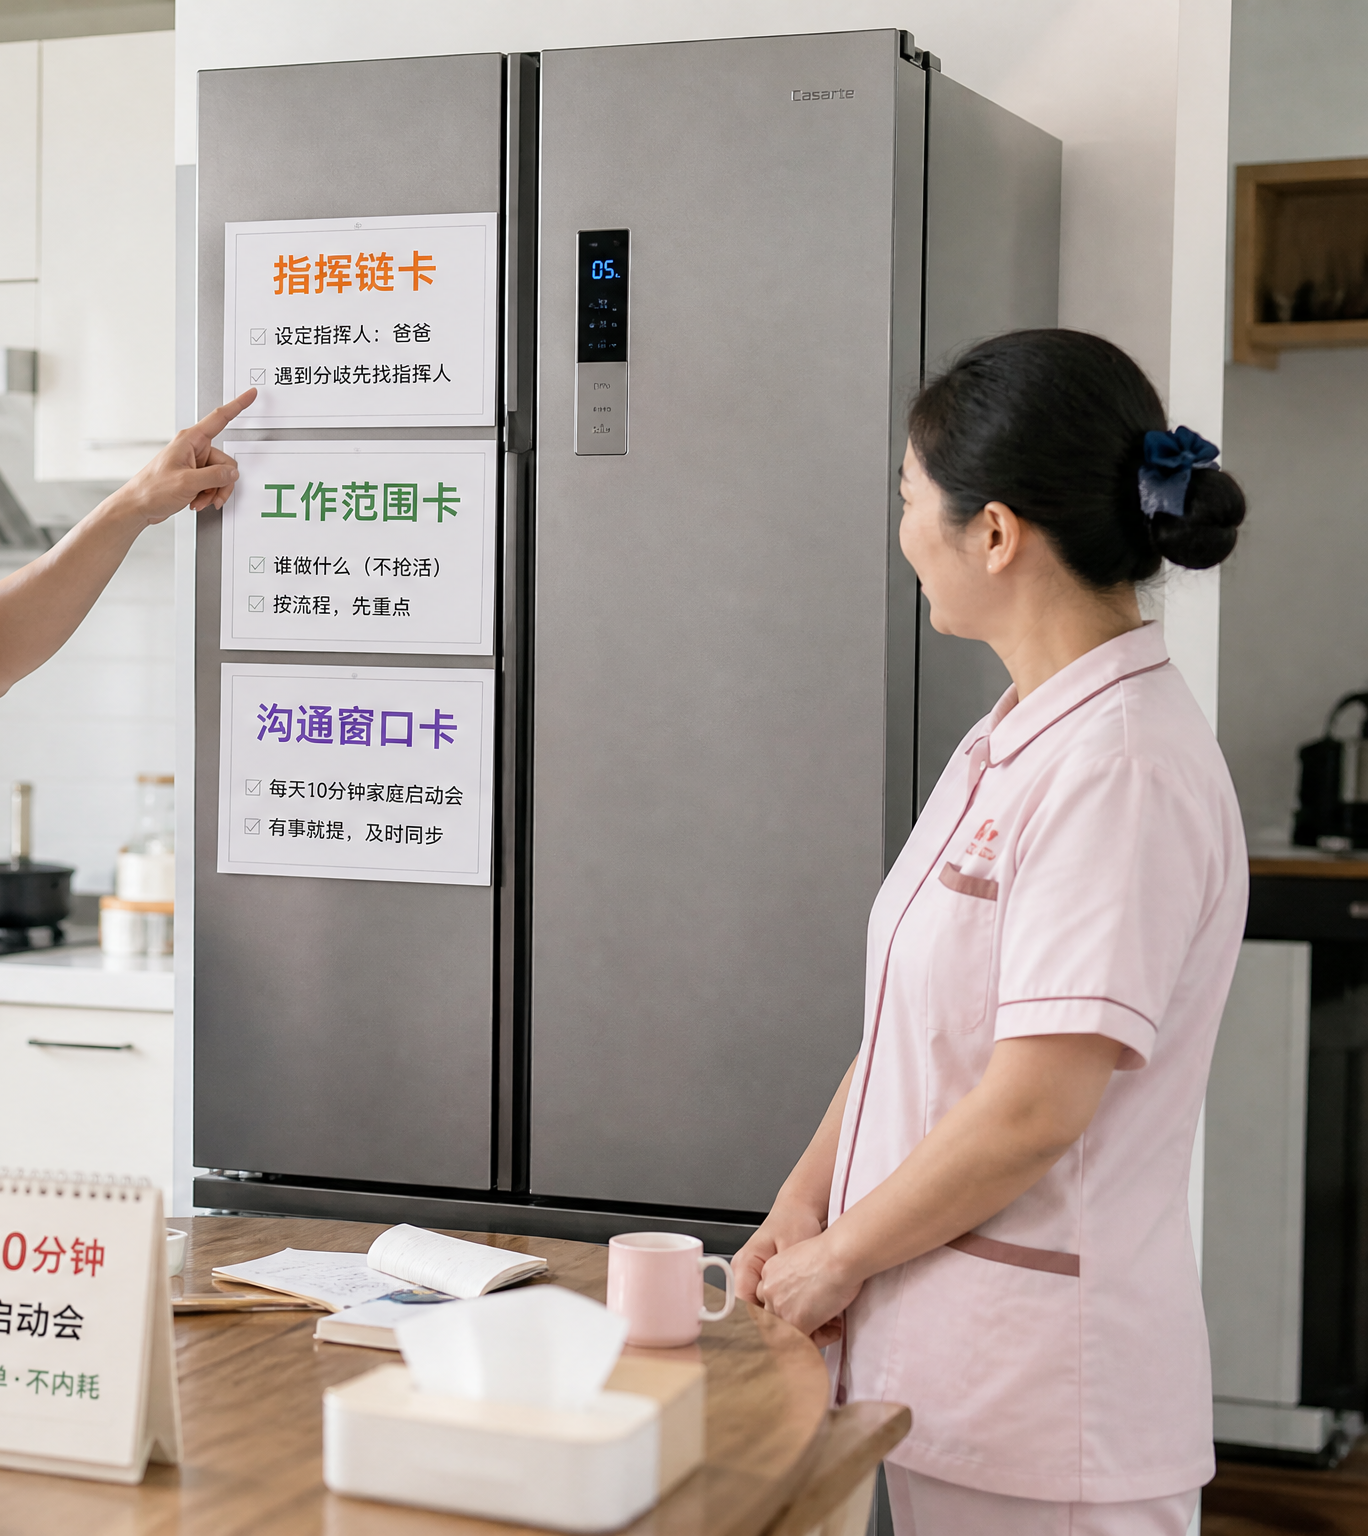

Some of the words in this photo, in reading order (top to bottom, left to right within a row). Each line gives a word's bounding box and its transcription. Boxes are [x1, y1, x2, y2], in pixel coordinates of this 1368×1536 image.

[273, 250, 437, 296] 指挥链卡
[274, 322, 432, 346] 设定指挥人：爸爸
[274, 363, 452, 386] 遇到分歧先找指挥人
[260, 480, 461, 523] 工作范围卡
[273, 555, 441, 578] 谁做什么（不抢活）
[272, 594, 411, 617] 按流程，先重点
[256, 702, 458, 750] 沟通窗口卡
[269, 778, 464, 806] 每天10分钟家庭启动会
[268, 817, 444, 846] 有事就提，及时同步
